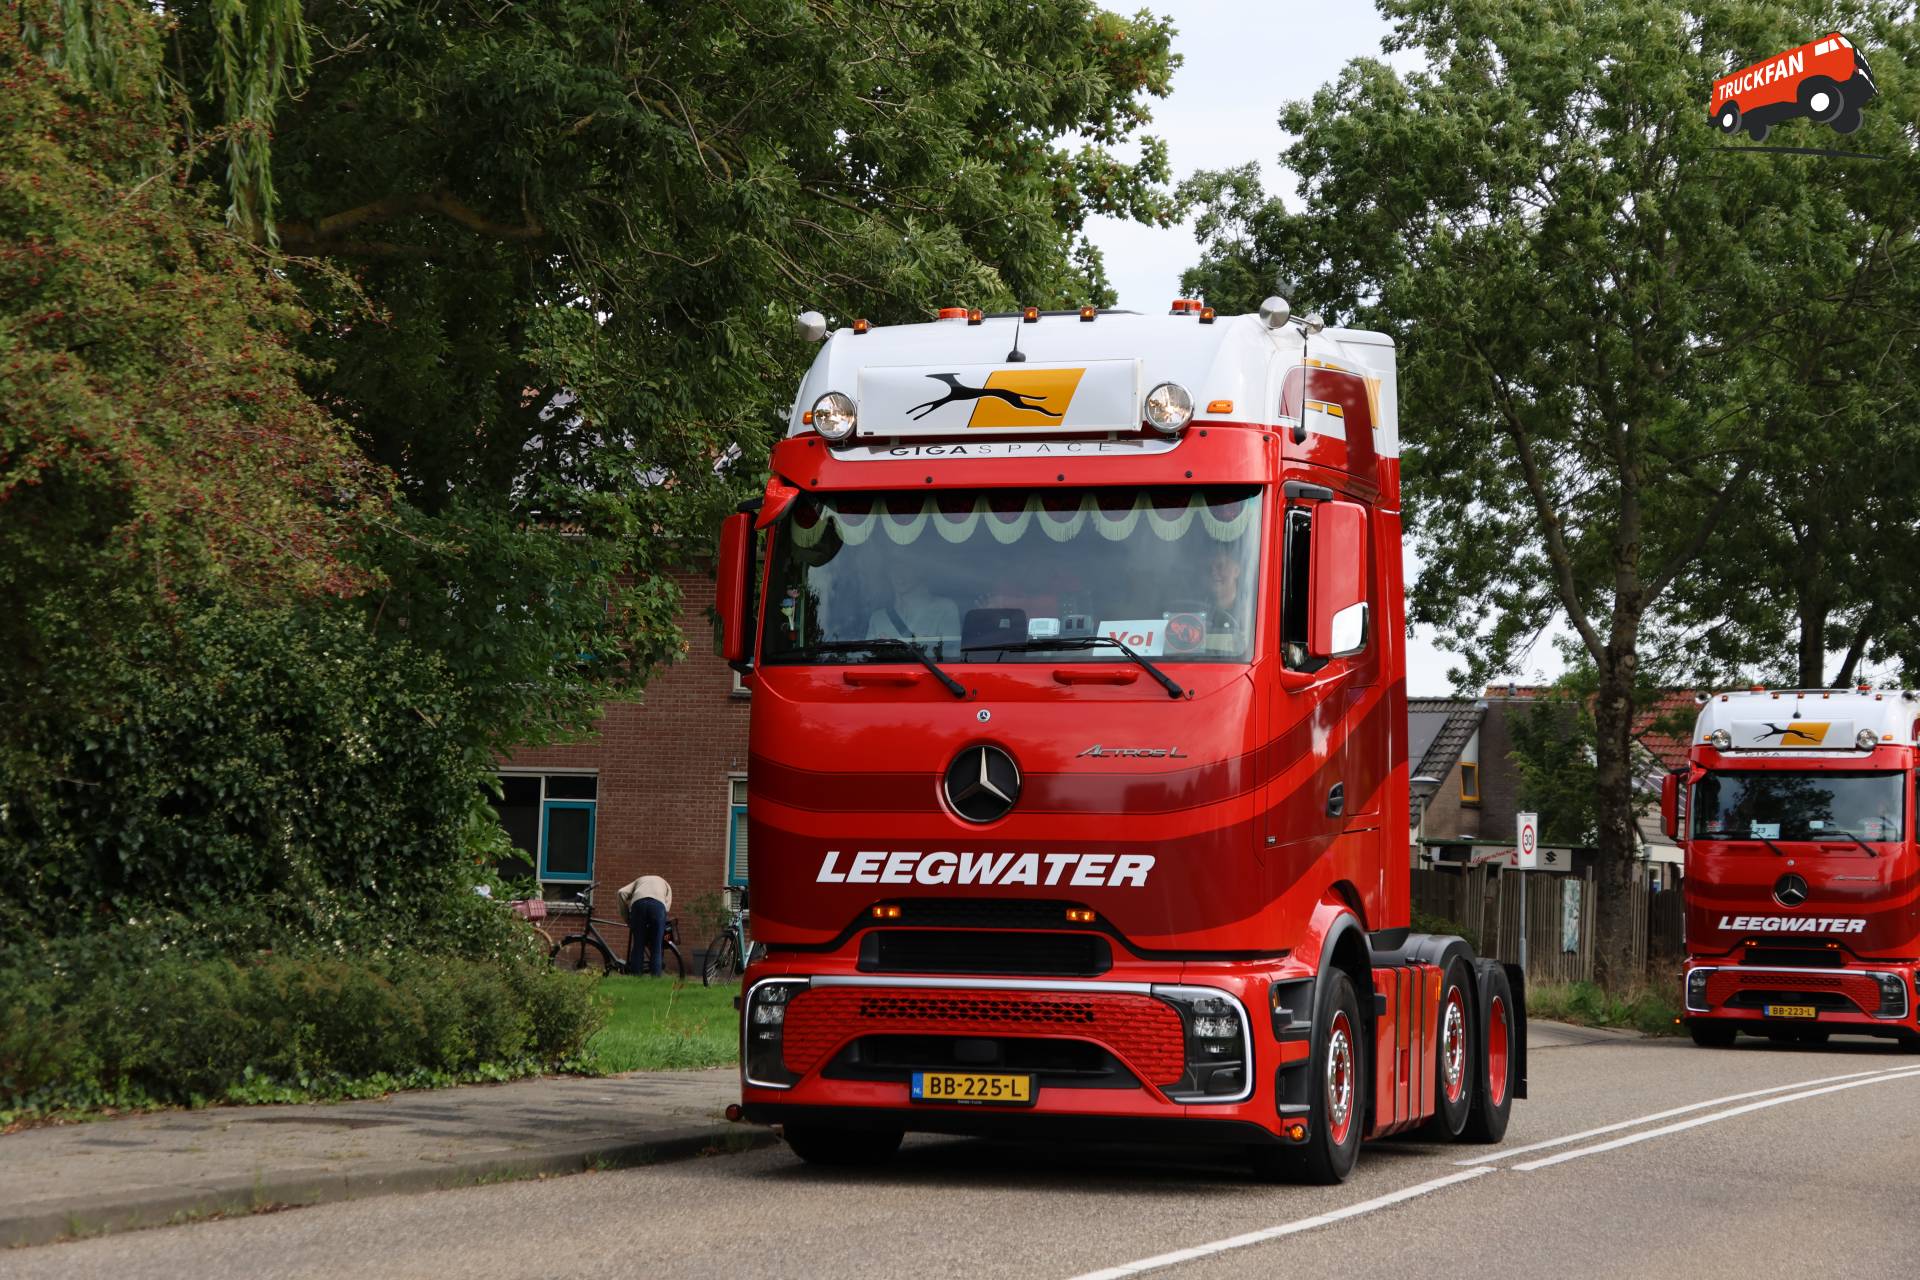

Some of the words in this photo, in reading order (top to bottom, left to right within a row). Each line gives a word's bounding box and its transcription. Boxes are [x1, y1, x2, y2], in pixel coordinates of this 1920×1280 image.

[1108, 631, 1154, 646] Vol
[1524, 834, 1532, 846] 30
[815, 851, 1156, 887] LEEGWATER
[1718, 916, 1867, 933] LEEGWATER
[1773, 1007, 1813, 1016] BB-223-L
[930, 1076, 1022, 1097] BB-225-L
